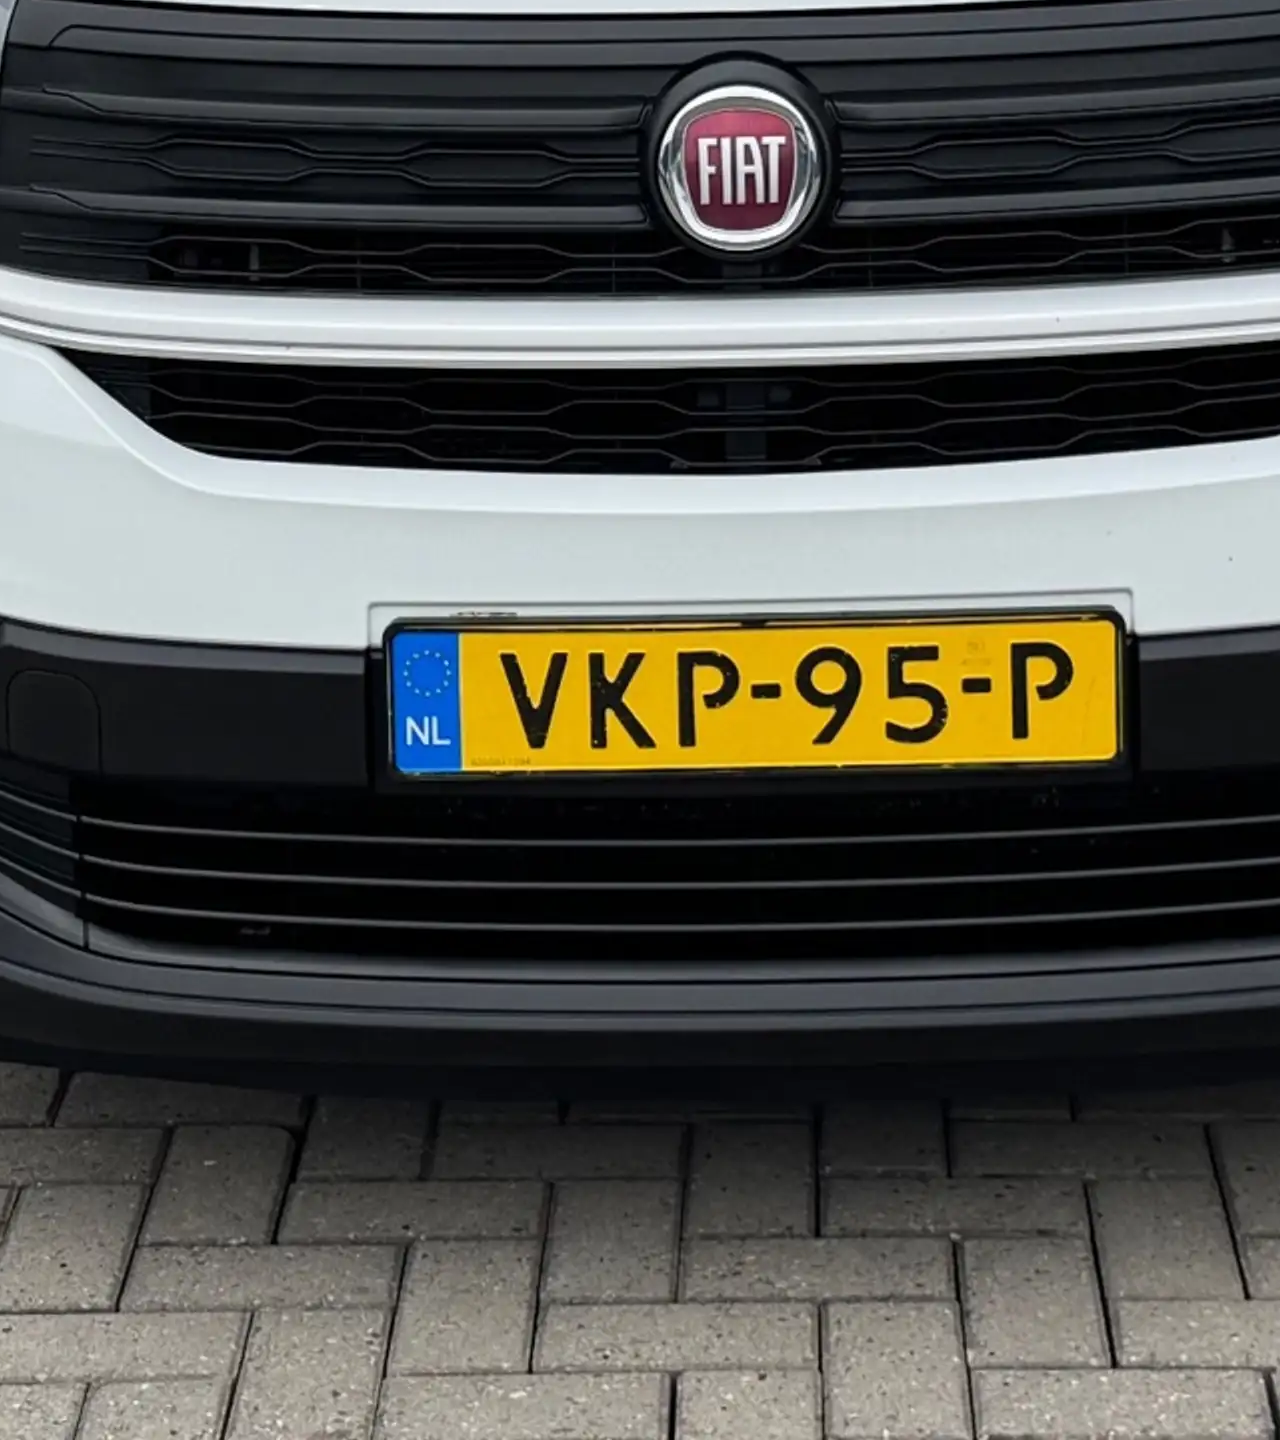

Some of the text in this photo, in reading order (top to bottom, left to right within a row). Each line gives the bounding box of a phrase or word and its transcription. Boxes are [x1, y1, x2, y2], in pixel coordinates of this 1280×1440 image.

[697, 135, 787, 206] FIAT
[405, 715, 452, 746] NL
[499, 641, 1075, 750] VKP-95-P
